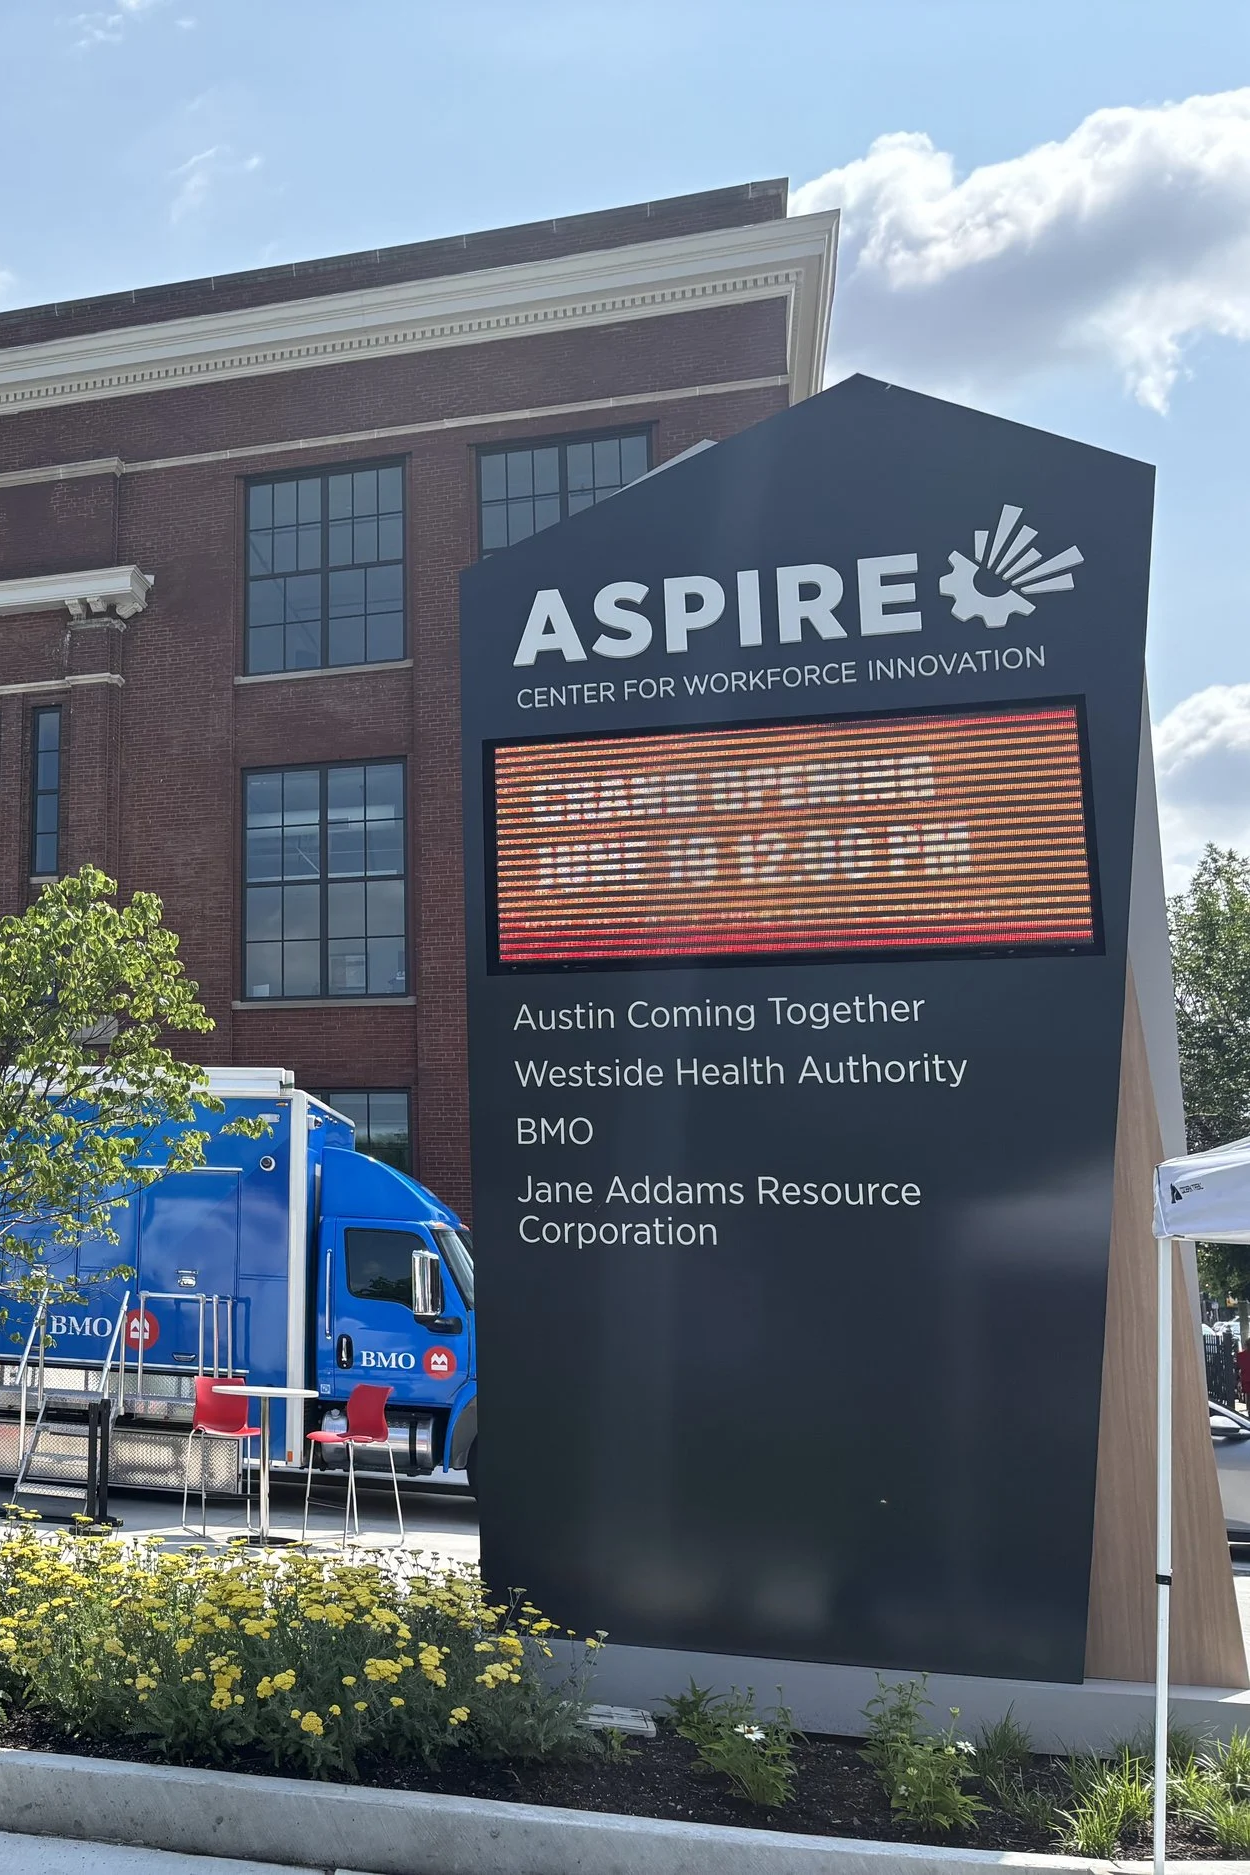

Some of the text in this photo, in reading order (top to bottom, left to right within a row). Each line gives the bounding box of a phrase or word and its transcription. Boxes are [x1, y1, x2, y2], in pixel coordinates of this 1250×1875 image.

[513, 552, 923, 667] ASPIRE
[516, 645, 1046, 709] CENTER FOR WORKFORCE INNOVATION
[513, 994, 925, 1031] Austin Coming Together
[514, 1053, 968, 1088] Westside Health Authority
[517, 1117, 593, 1145] BMO
[517, 1175, 922, 1206] Jane Addams Resource
[519, 1215, 718, 1250] Corporation
[50, 1315, 113, 1338] BMO
[360, 1350, 416, 1370] BMO
